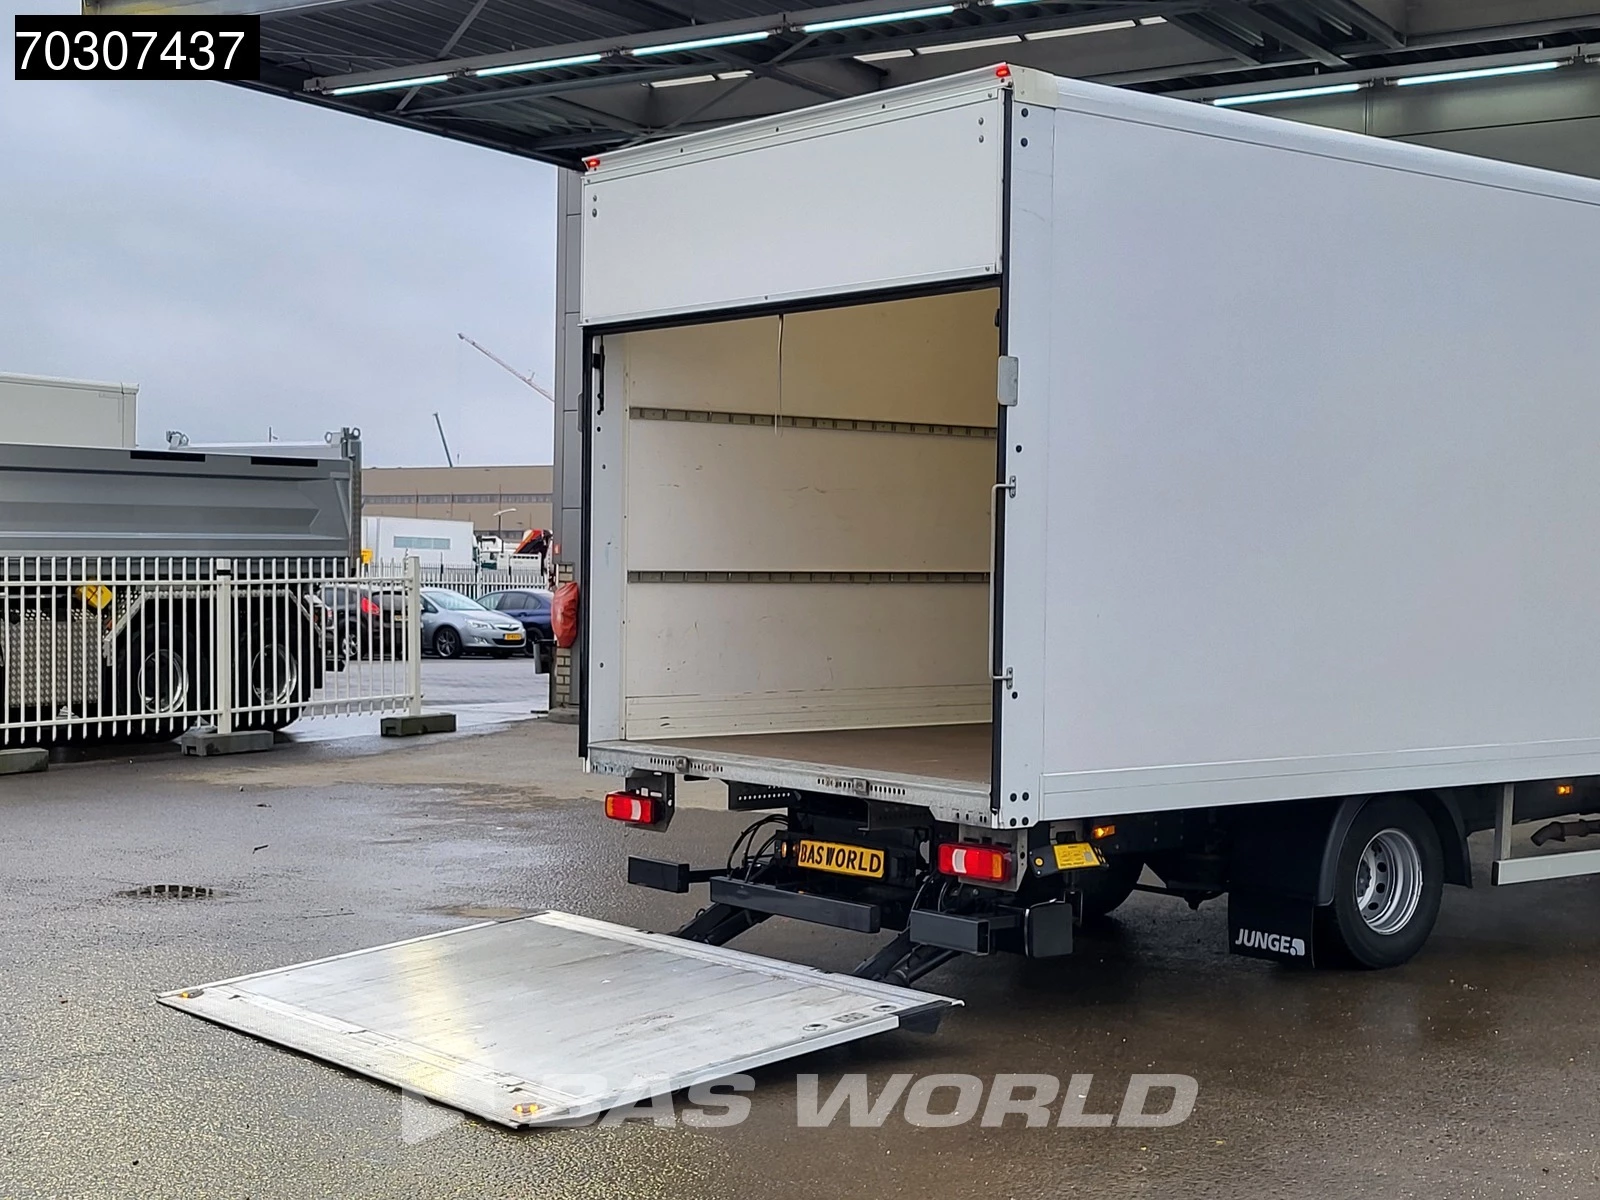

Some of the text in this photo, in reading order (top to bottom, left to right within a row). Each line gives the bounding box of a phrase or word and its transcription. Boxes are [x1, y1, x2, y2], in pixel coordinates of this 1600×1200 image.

[800, 843, 882, 873] BAS WORLD
[1234, 928, 1291, 954] JUNGE
